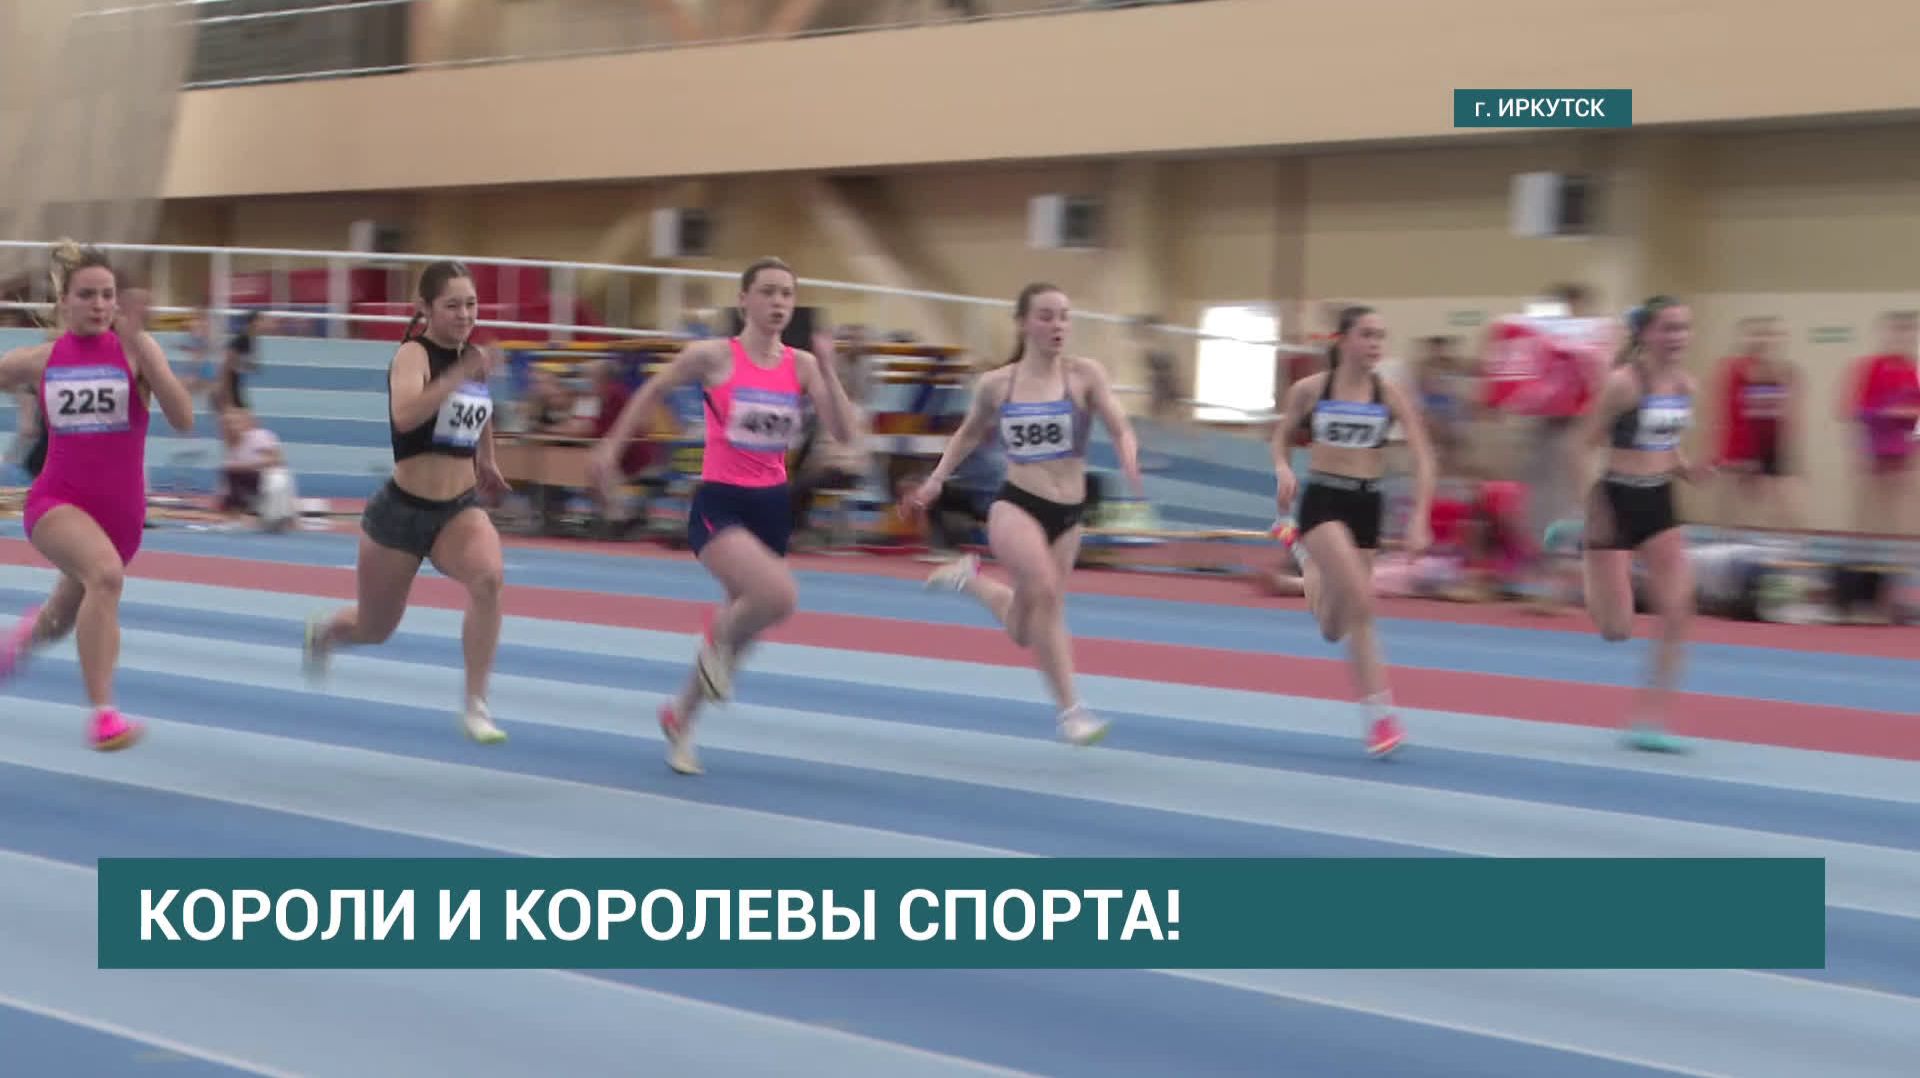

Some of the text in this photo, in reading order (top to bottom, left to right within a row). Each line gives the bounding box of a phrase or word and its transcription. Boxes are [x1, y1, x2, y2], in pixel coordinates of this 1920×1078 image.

[58, 388, 115, 415] 225
[449, 401, 487, 429] 349
[1010, 423, 1063, 447] 388
